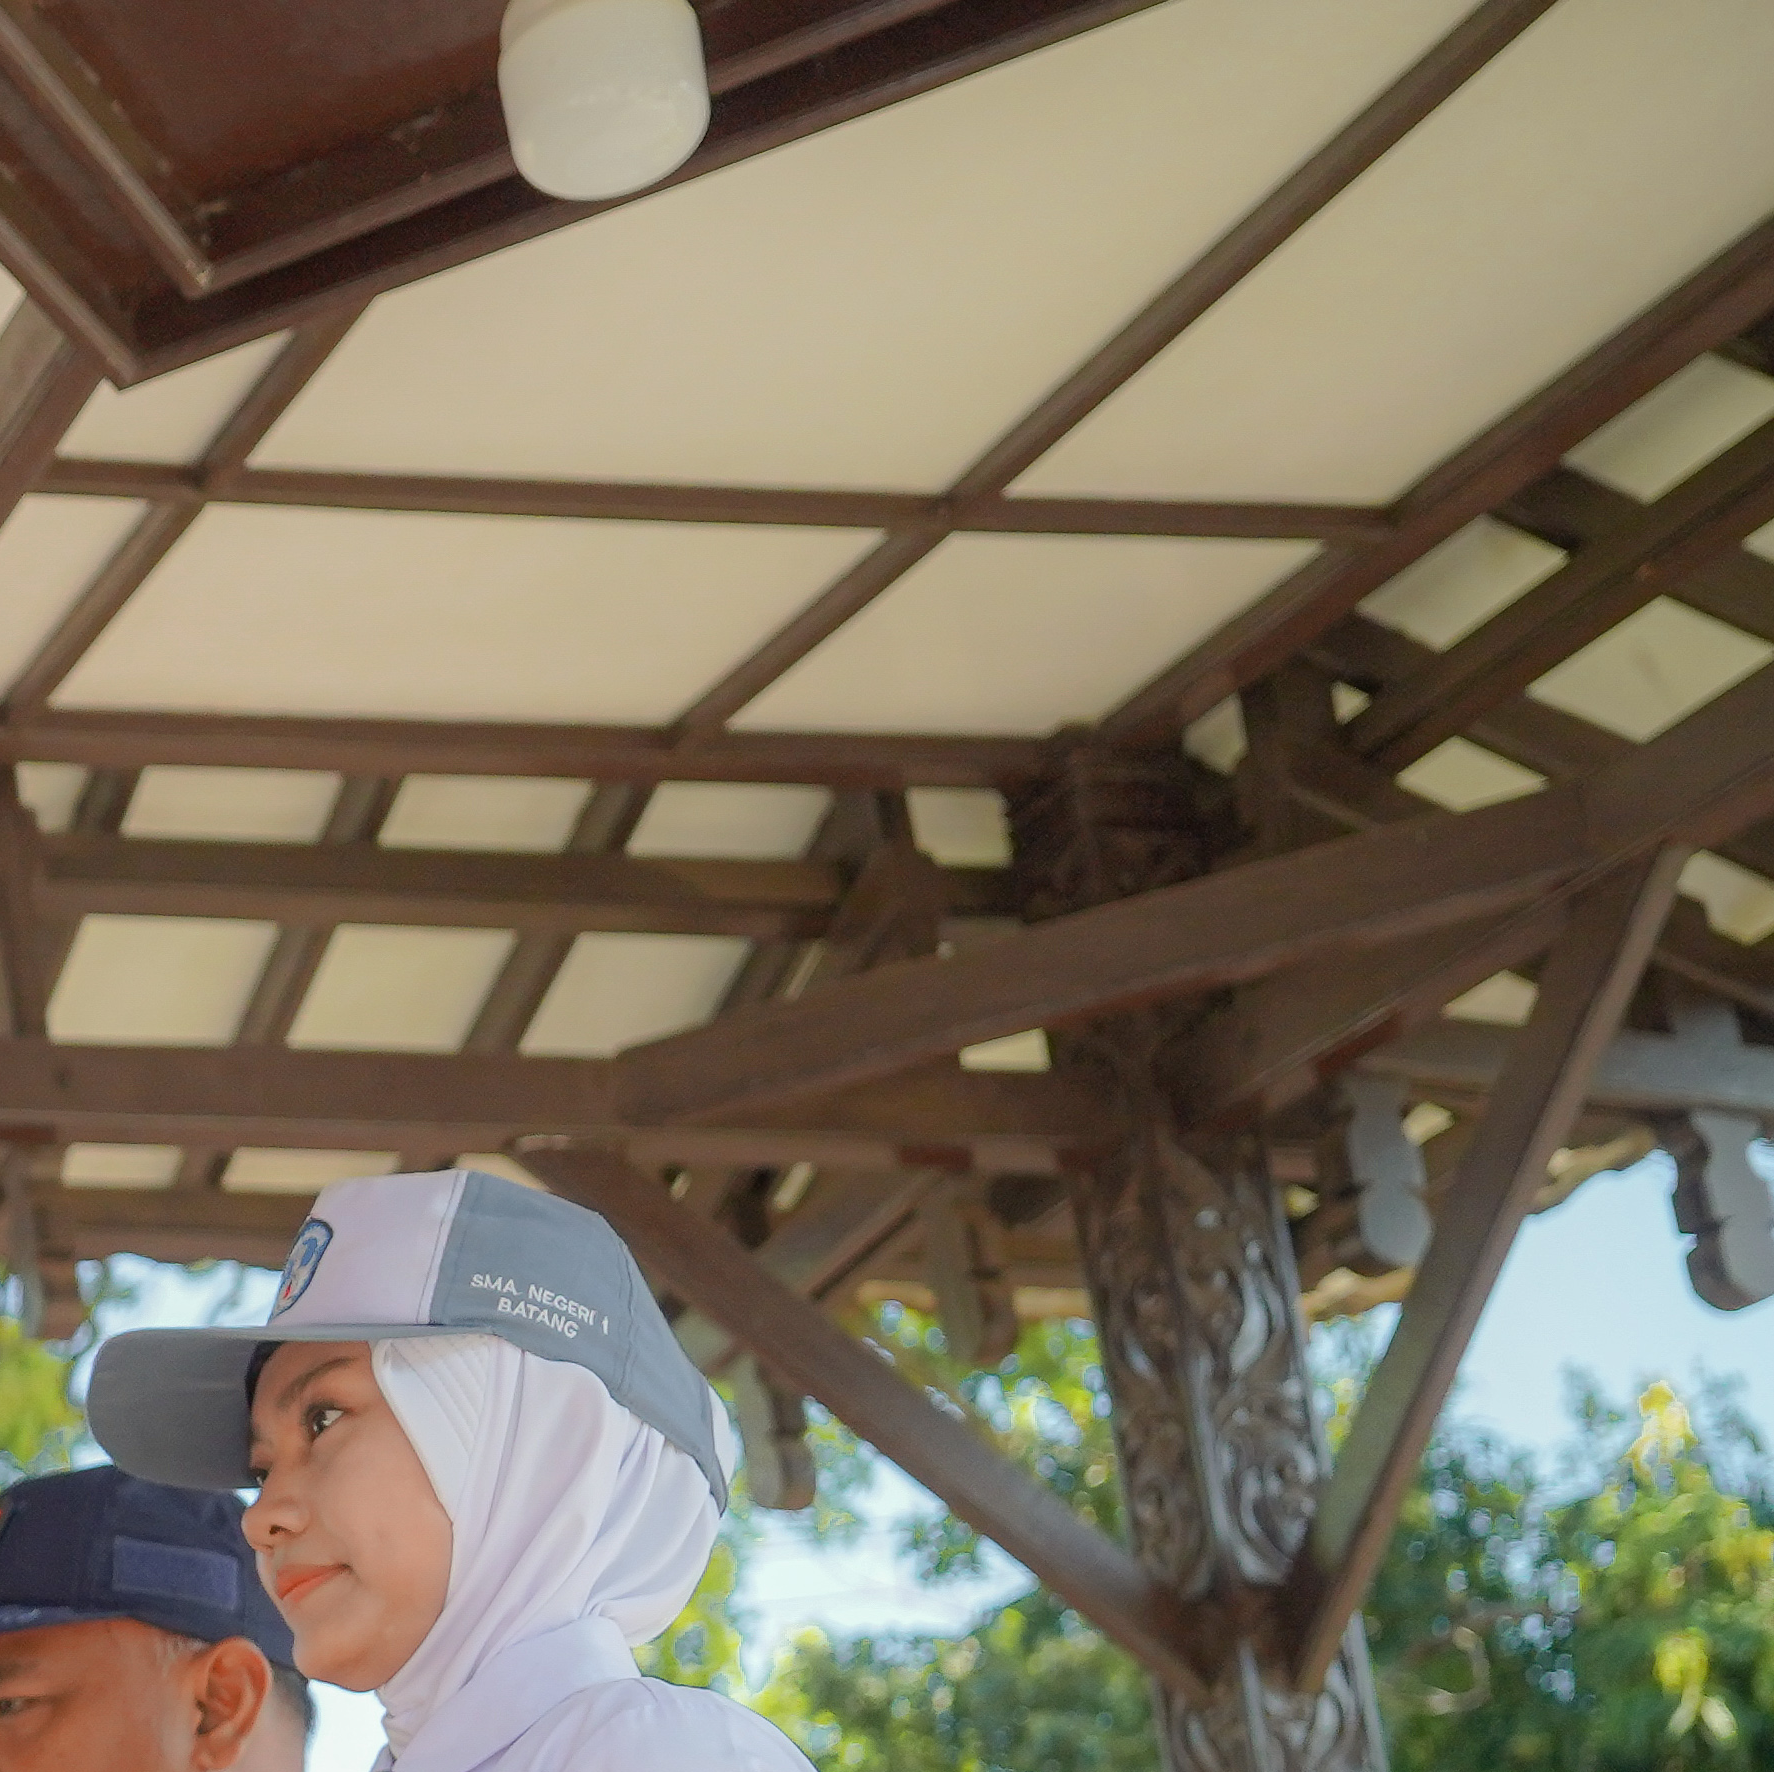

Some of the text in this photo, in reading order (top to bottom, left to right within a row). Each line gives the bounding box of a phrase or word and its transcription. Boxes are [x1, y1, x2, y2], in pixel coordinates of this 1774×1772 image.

[470, 1273, 609, 1336] SMA NEGERI 1
[497, 1296, 579, 1339] BATANG
